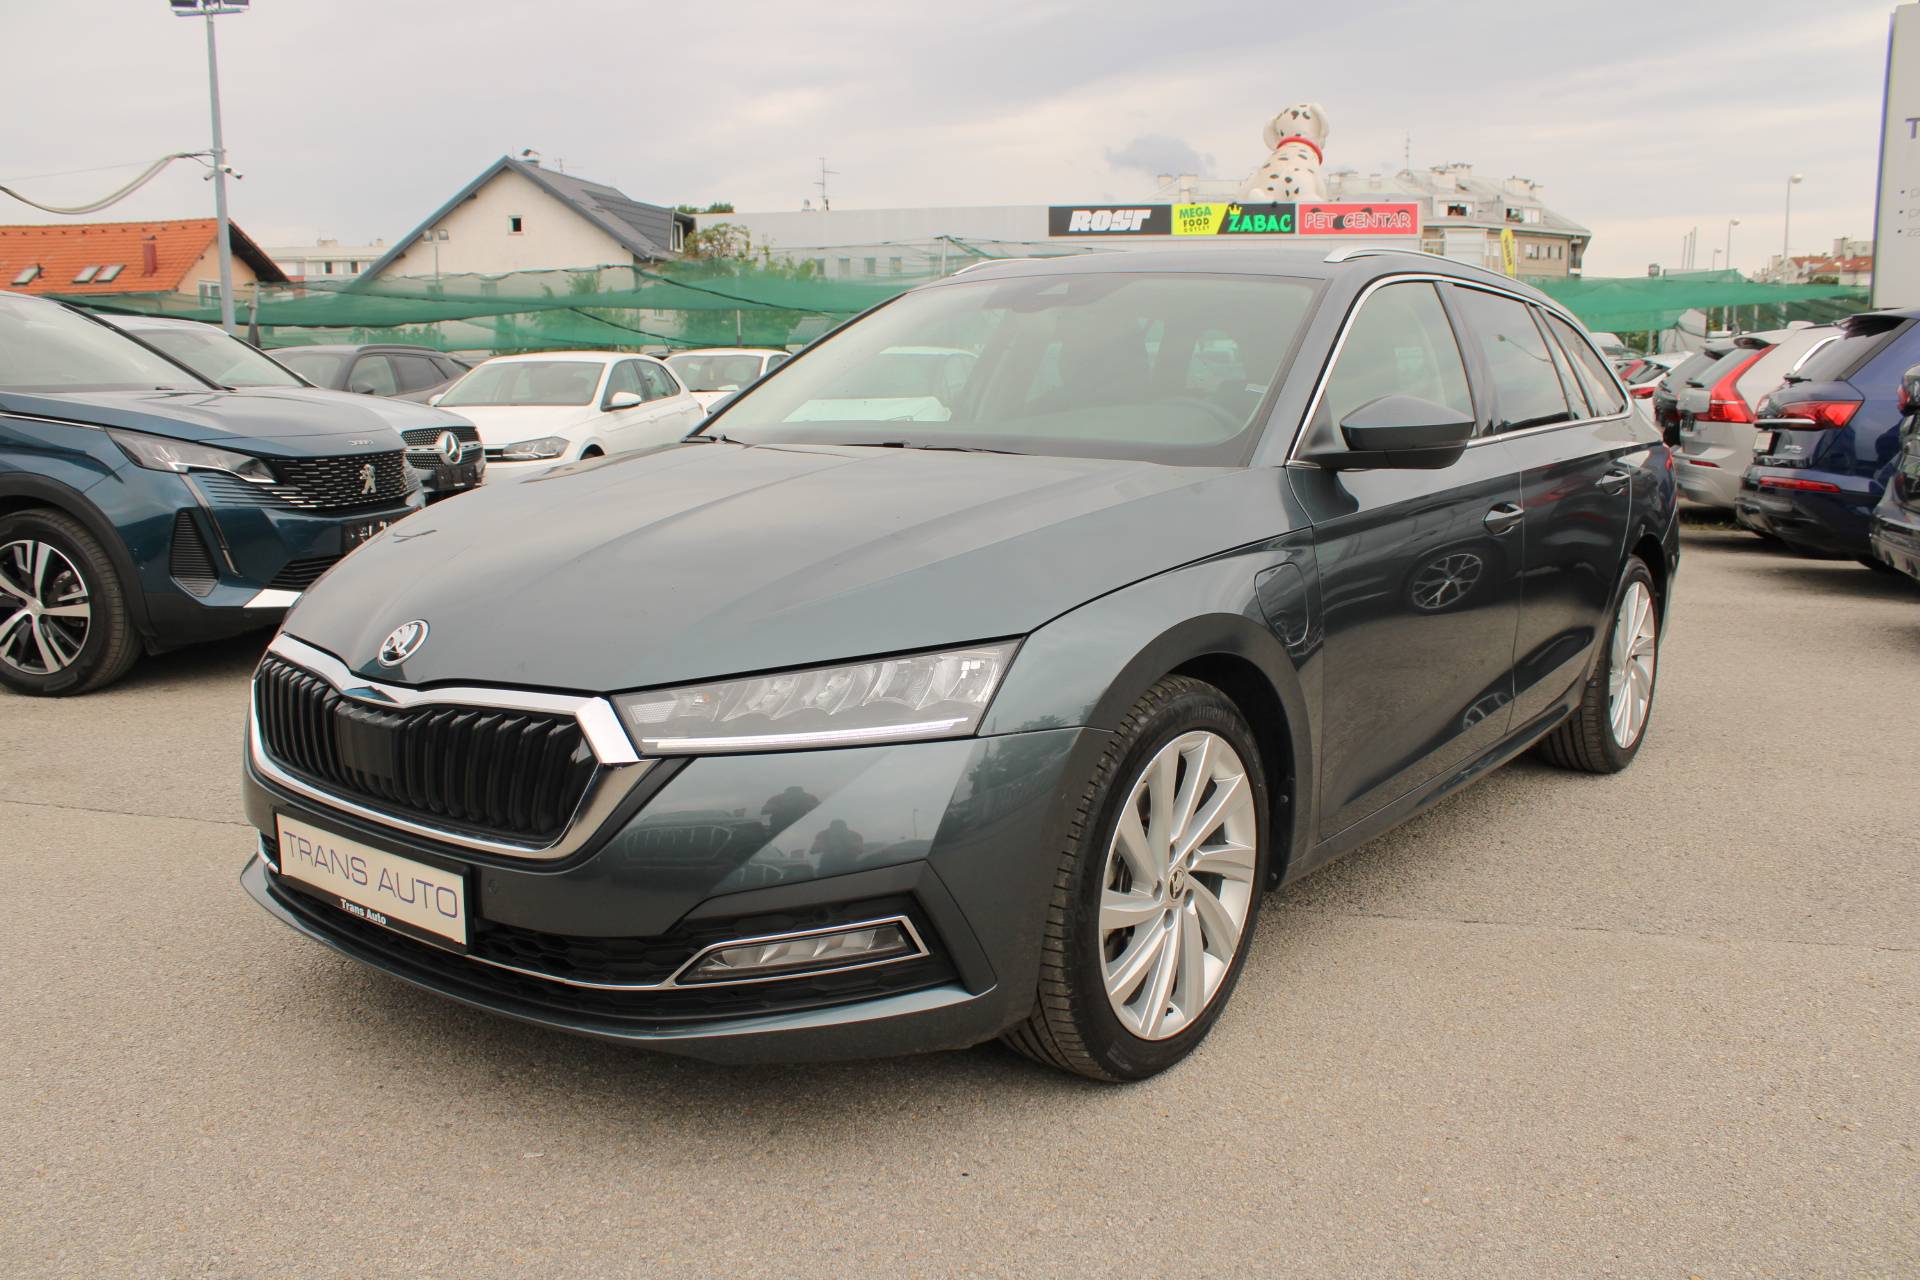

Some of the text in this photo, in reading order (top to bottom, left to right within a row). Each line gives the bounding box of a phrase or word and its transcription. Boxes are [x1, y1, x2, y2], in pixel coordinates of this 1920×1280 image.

[1069, 209, 1152, 232] ROST
[1179, 206, 1212, 219] MEGA
[1183, 217, 1210, 227] FOOD
[1304, 212, 1411, 229] PET CENTAR
[283, 831, 458, 919] TRANS AUTO
[340, 898, 387, 925] Trans Auto
